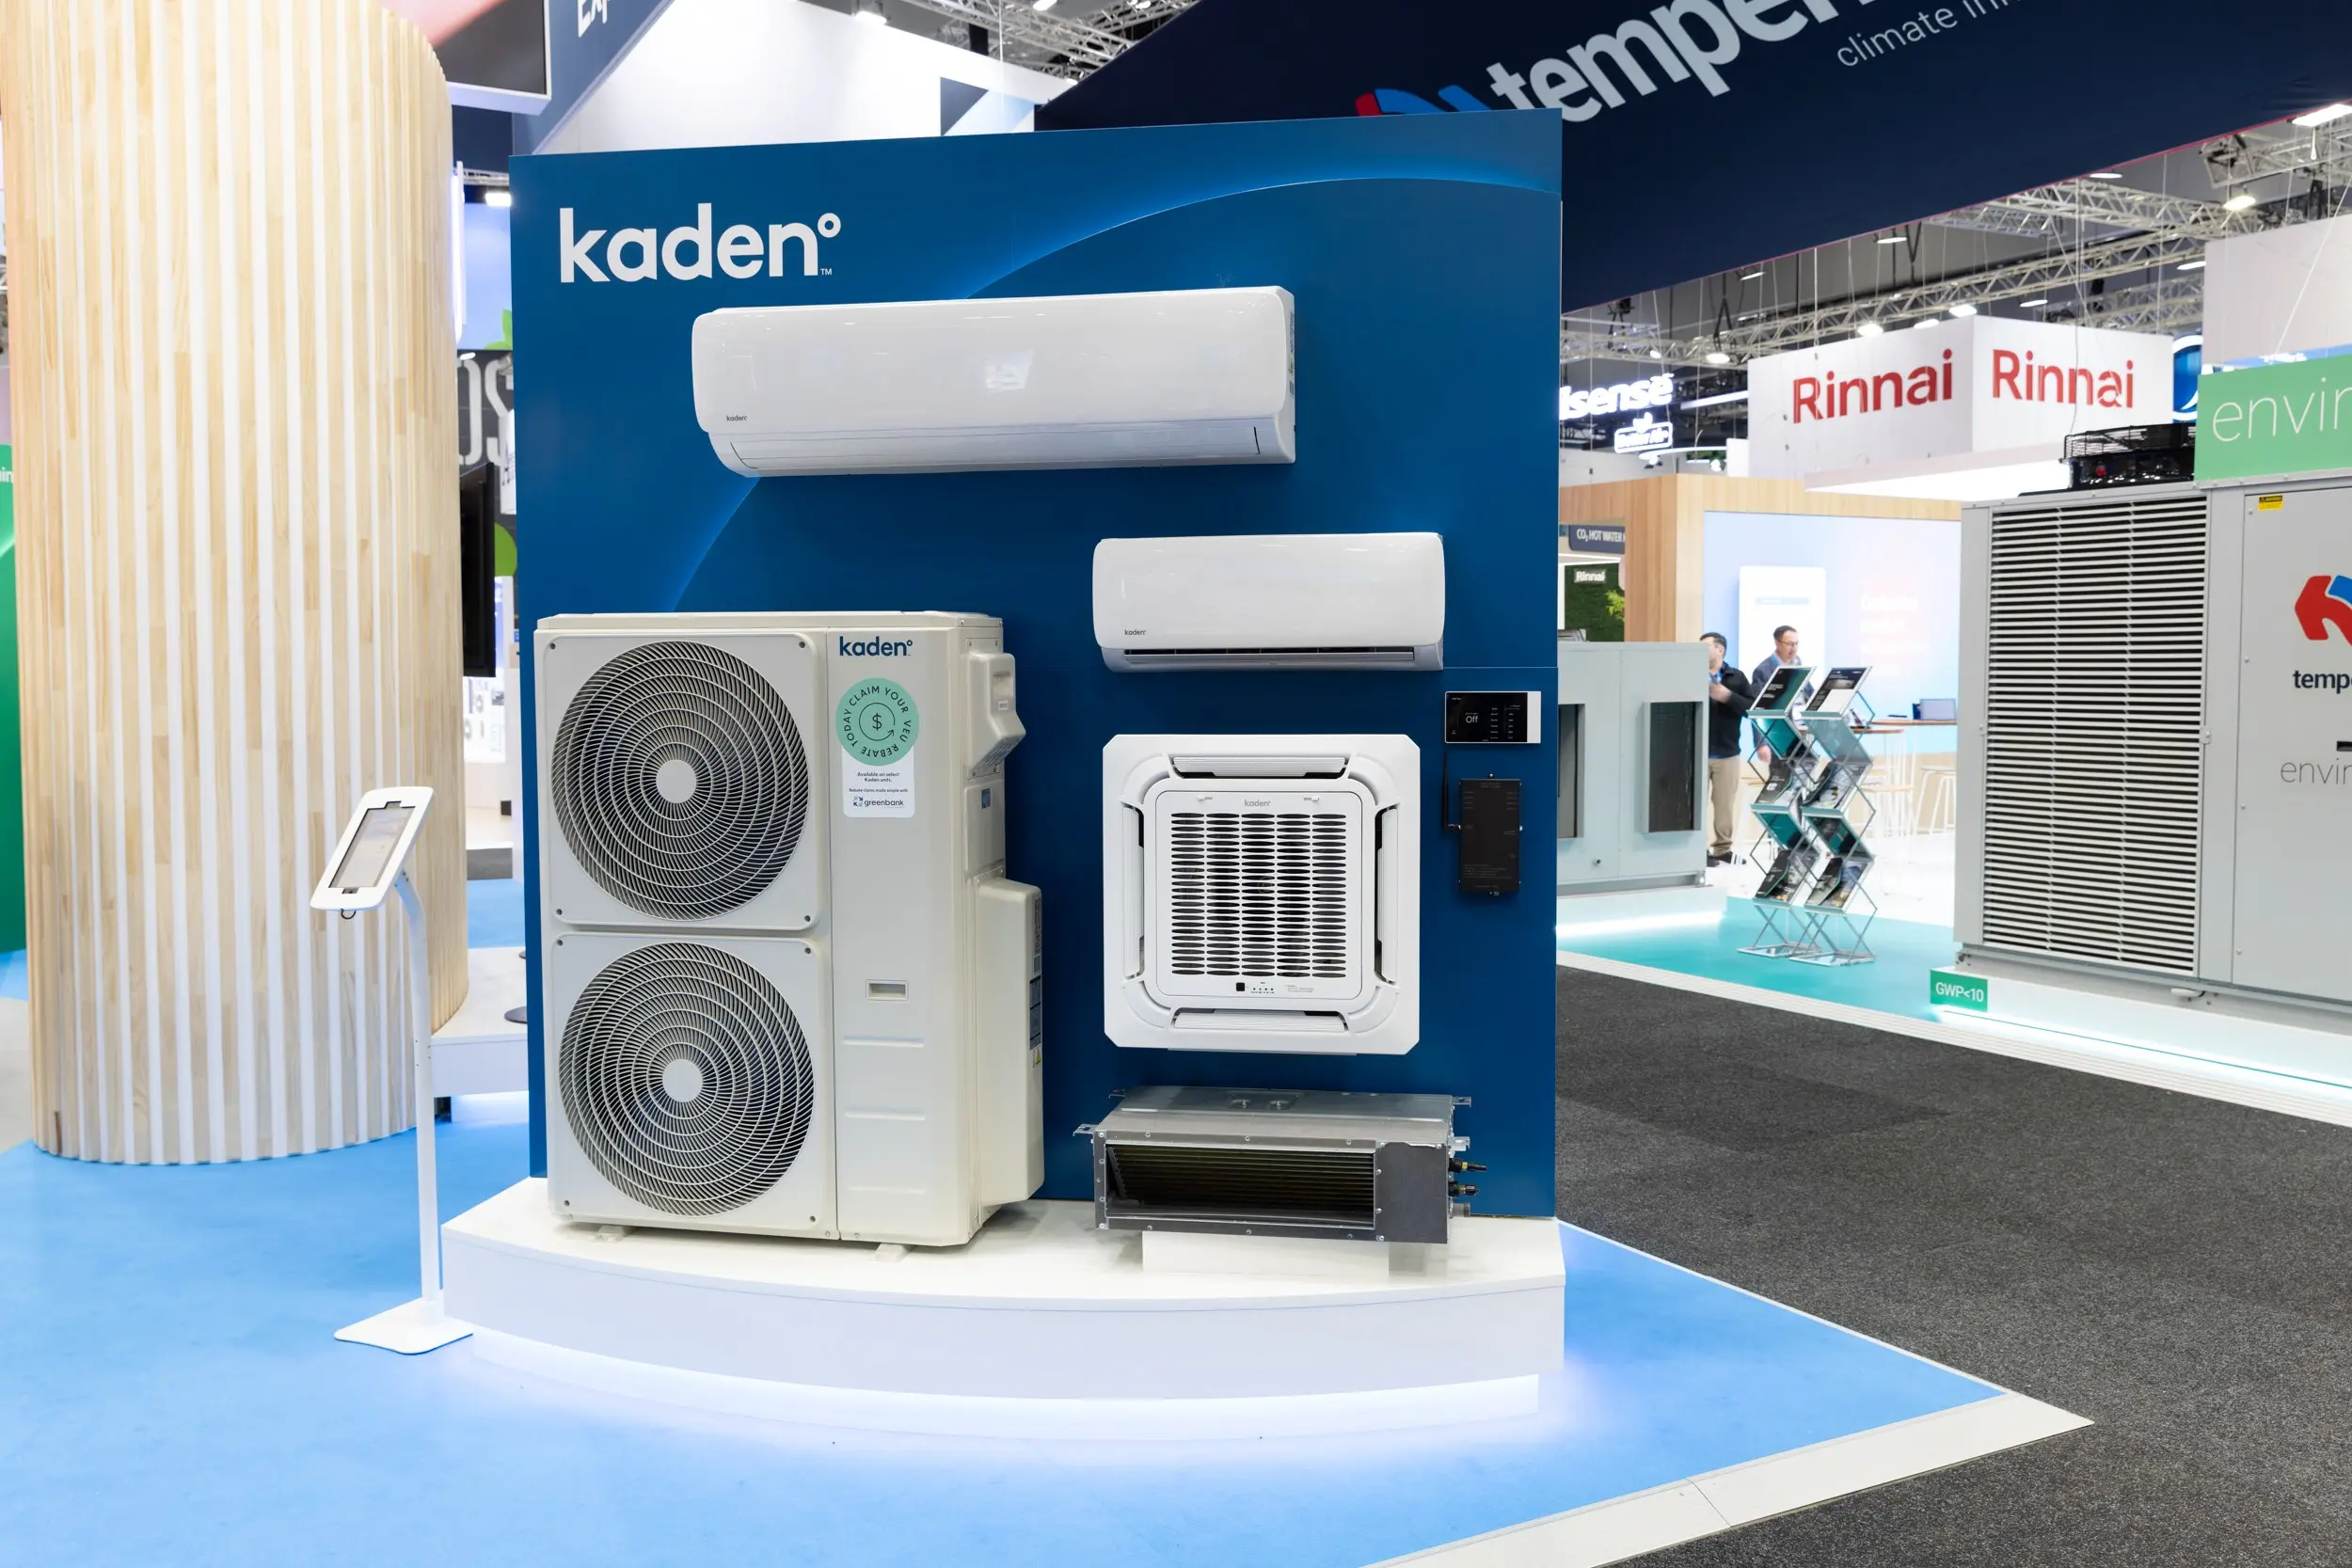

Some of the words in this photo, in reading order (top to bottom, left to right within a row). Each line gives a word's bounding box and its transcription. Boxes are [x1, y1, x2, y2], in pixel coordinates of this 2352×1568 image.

[1837, 8, 1958, 67] climate
[1486, 0, 1875, 122] tempe
[1793, 348, 1952, 423] Rinnai
[1993, 348, 2134, 408] Rinnai
[2213, 377, 2352, 442] envir
[1589, 530, 1601, 542] HOT
[1602, 531, 1622, 543] WATER
[1576, 570, 1606, 582] Rinnai
[2293, 670, 2352, 694] temp
[849, 686, 880, 706] CLAIM
[884, 687, 909, 713] YOUR
[843, 708, 858, 747] TODAY
[899, 720, 912, 742] VEU
[1466, 715, 1478, 723] Off
[861, 743, 899, 758] REBATE
[2280, 757, 2352, 785] envir
[1935, 981, 1984, 1003] GWP<10
